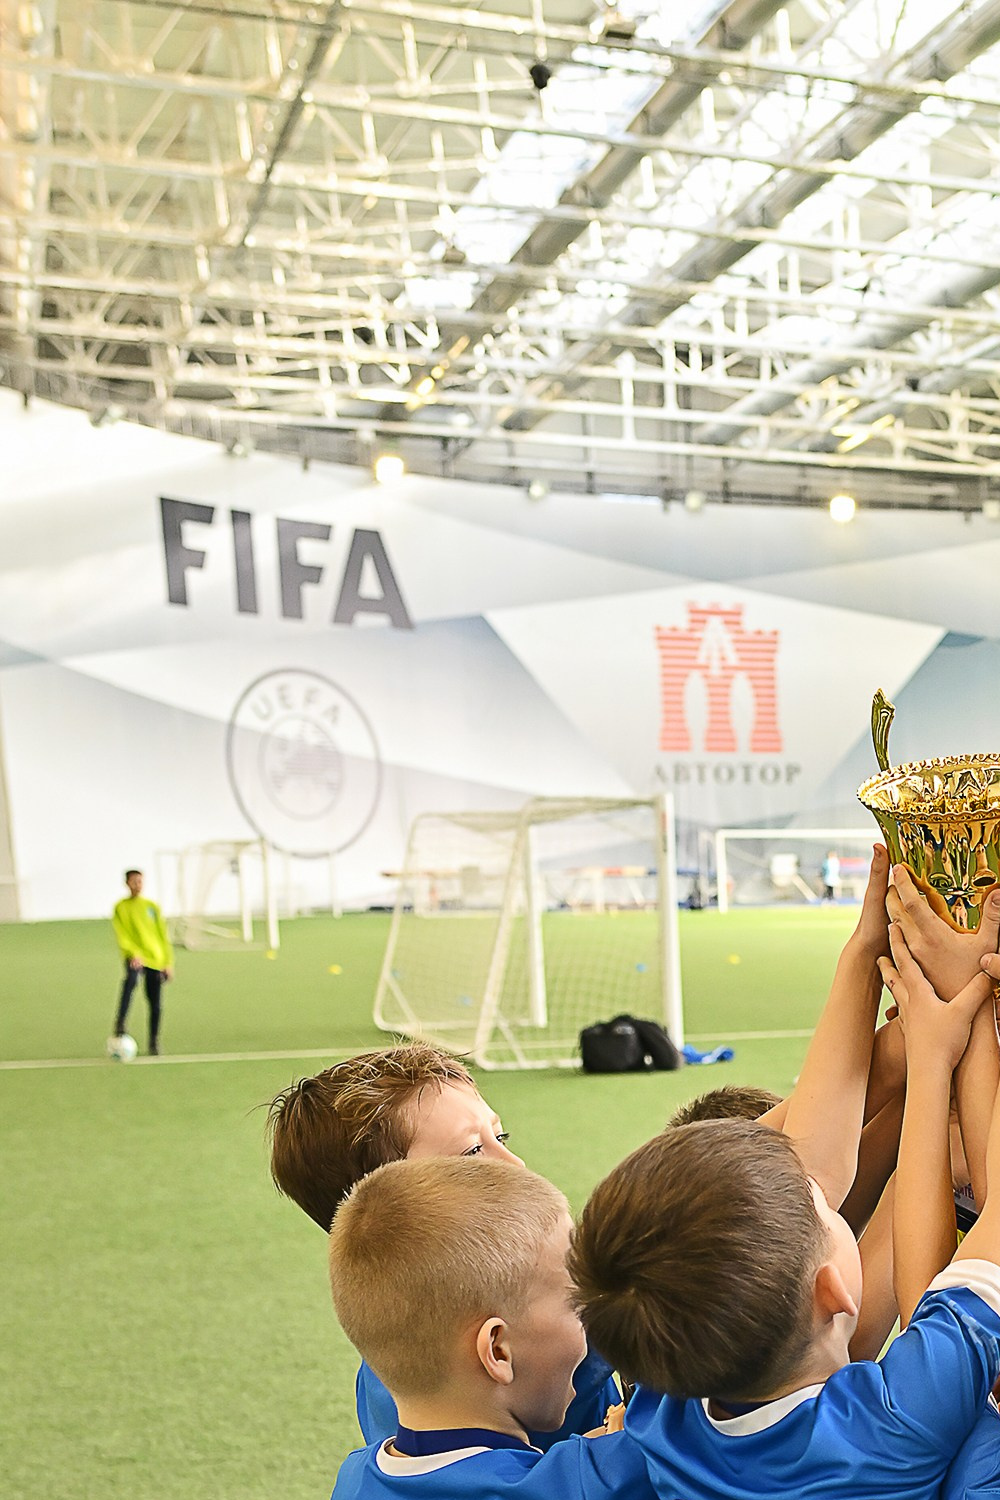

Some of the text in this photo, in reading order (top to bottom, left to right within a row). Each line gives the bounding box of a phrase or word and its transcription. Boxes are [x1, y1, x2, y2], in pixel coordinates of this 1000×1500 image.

[158, 496, 414, 629] FIFA
[252, 682, 340, 725] UEFA
[654, 761, 802, 786] АВТОТОР
